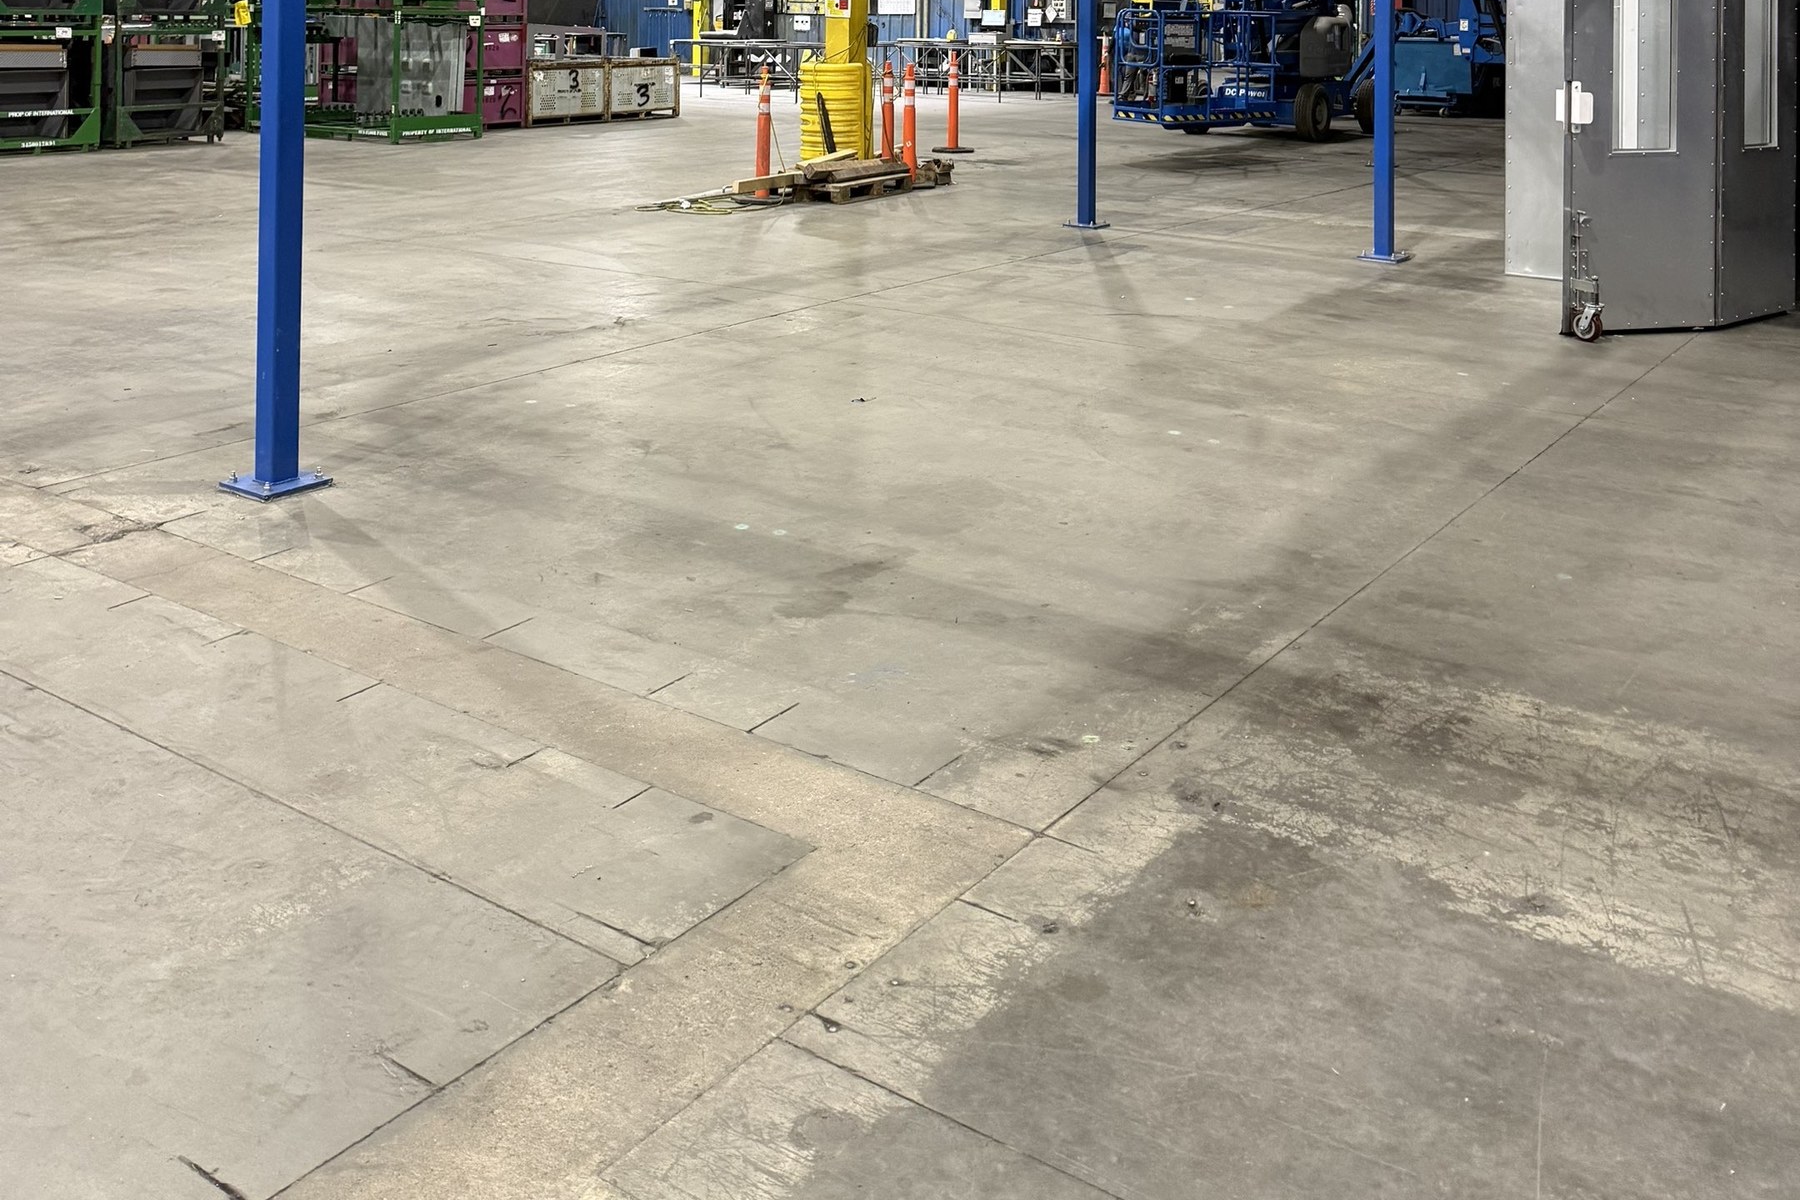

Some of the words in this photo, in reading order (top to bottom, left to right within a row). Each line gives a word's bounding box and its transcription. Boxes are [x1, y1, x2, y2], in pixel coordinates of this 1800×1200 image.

[568, 69, 580, 89] 3
[636, 83, 650, 107] 3
[1225, 87, 1237, 96] DC
[33, 109, 74, 117] INTERNATIONAL
